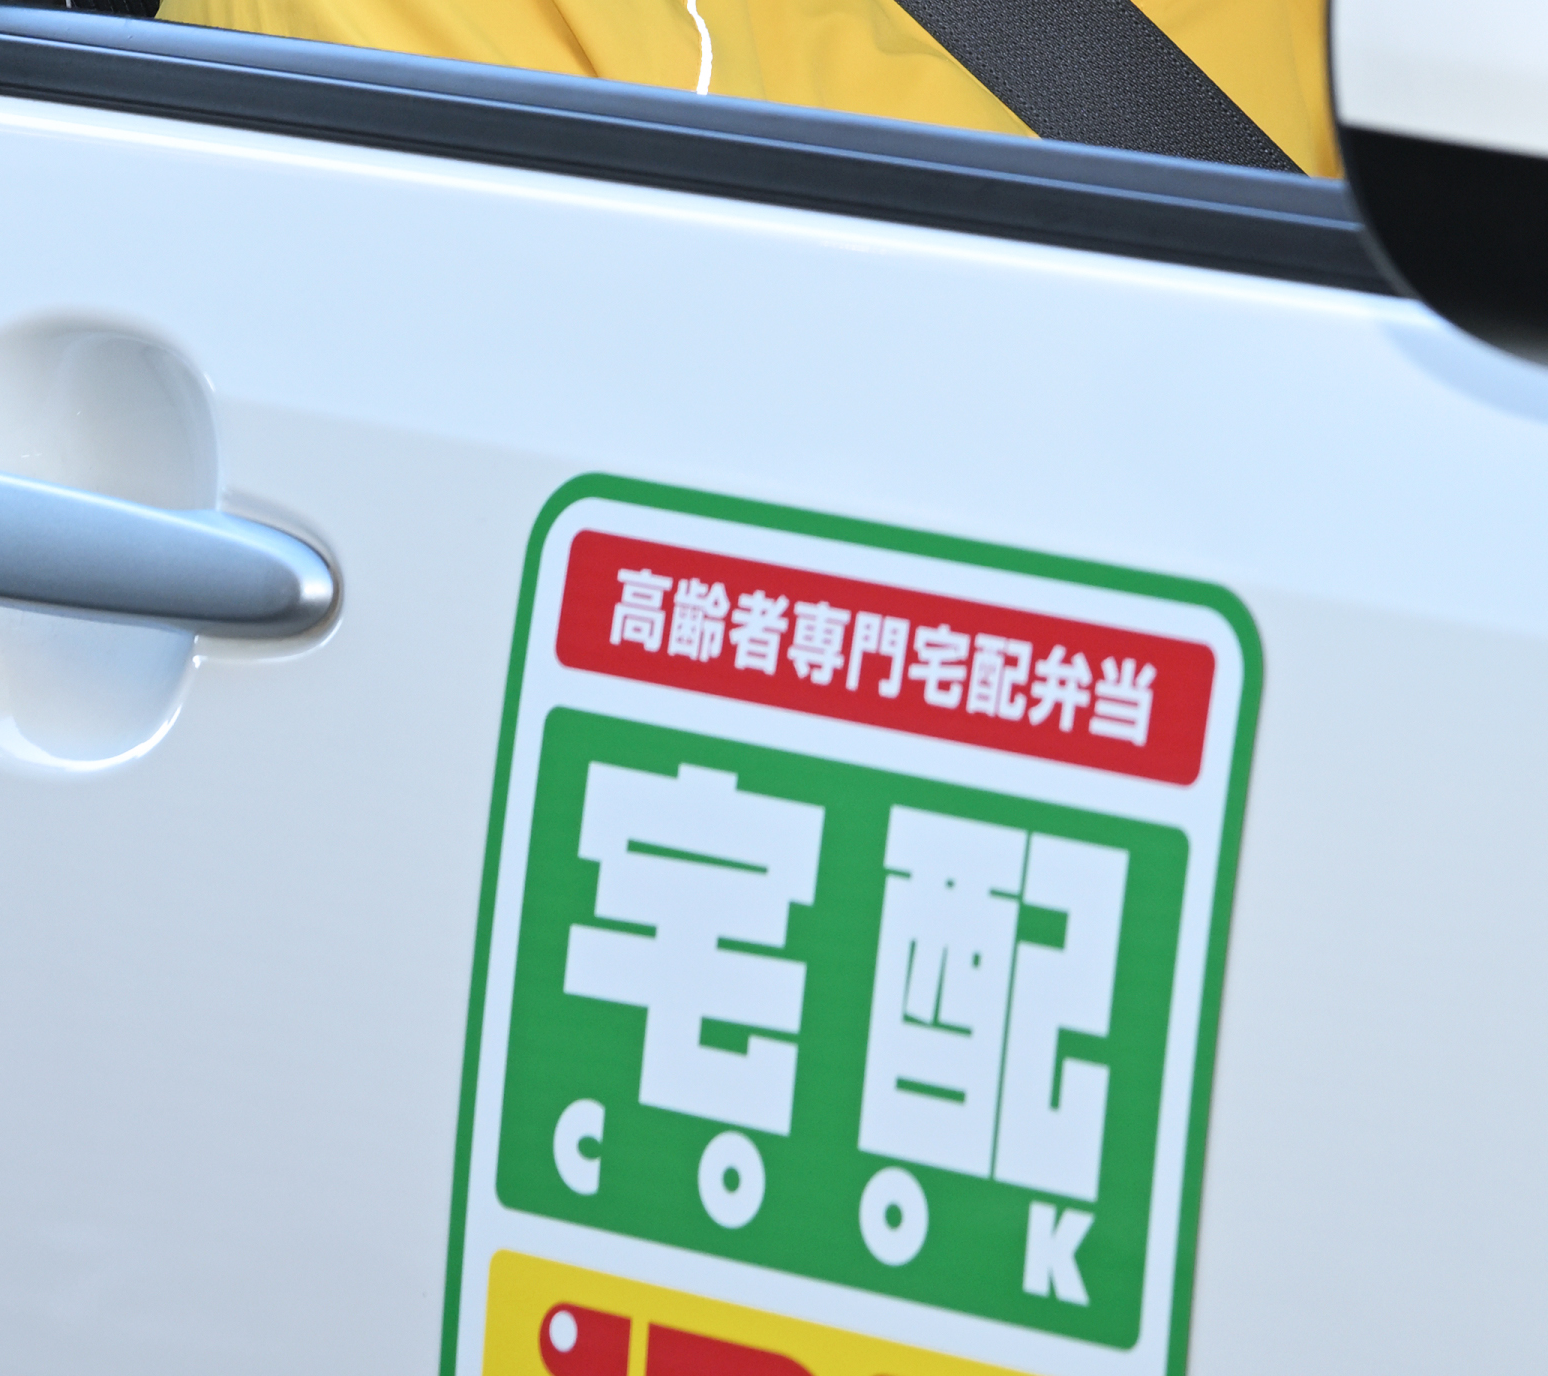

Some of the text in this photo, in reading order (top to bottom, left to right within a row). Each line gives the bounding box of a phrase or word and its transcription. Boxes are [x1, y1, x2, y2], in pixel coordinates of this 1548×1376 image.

[609, 568, 1157, 747] 高齢者専門宅配弁当
[563, 760, 1130, 1203] 宅配
[553, 1097, 1095, 1307] COOK
